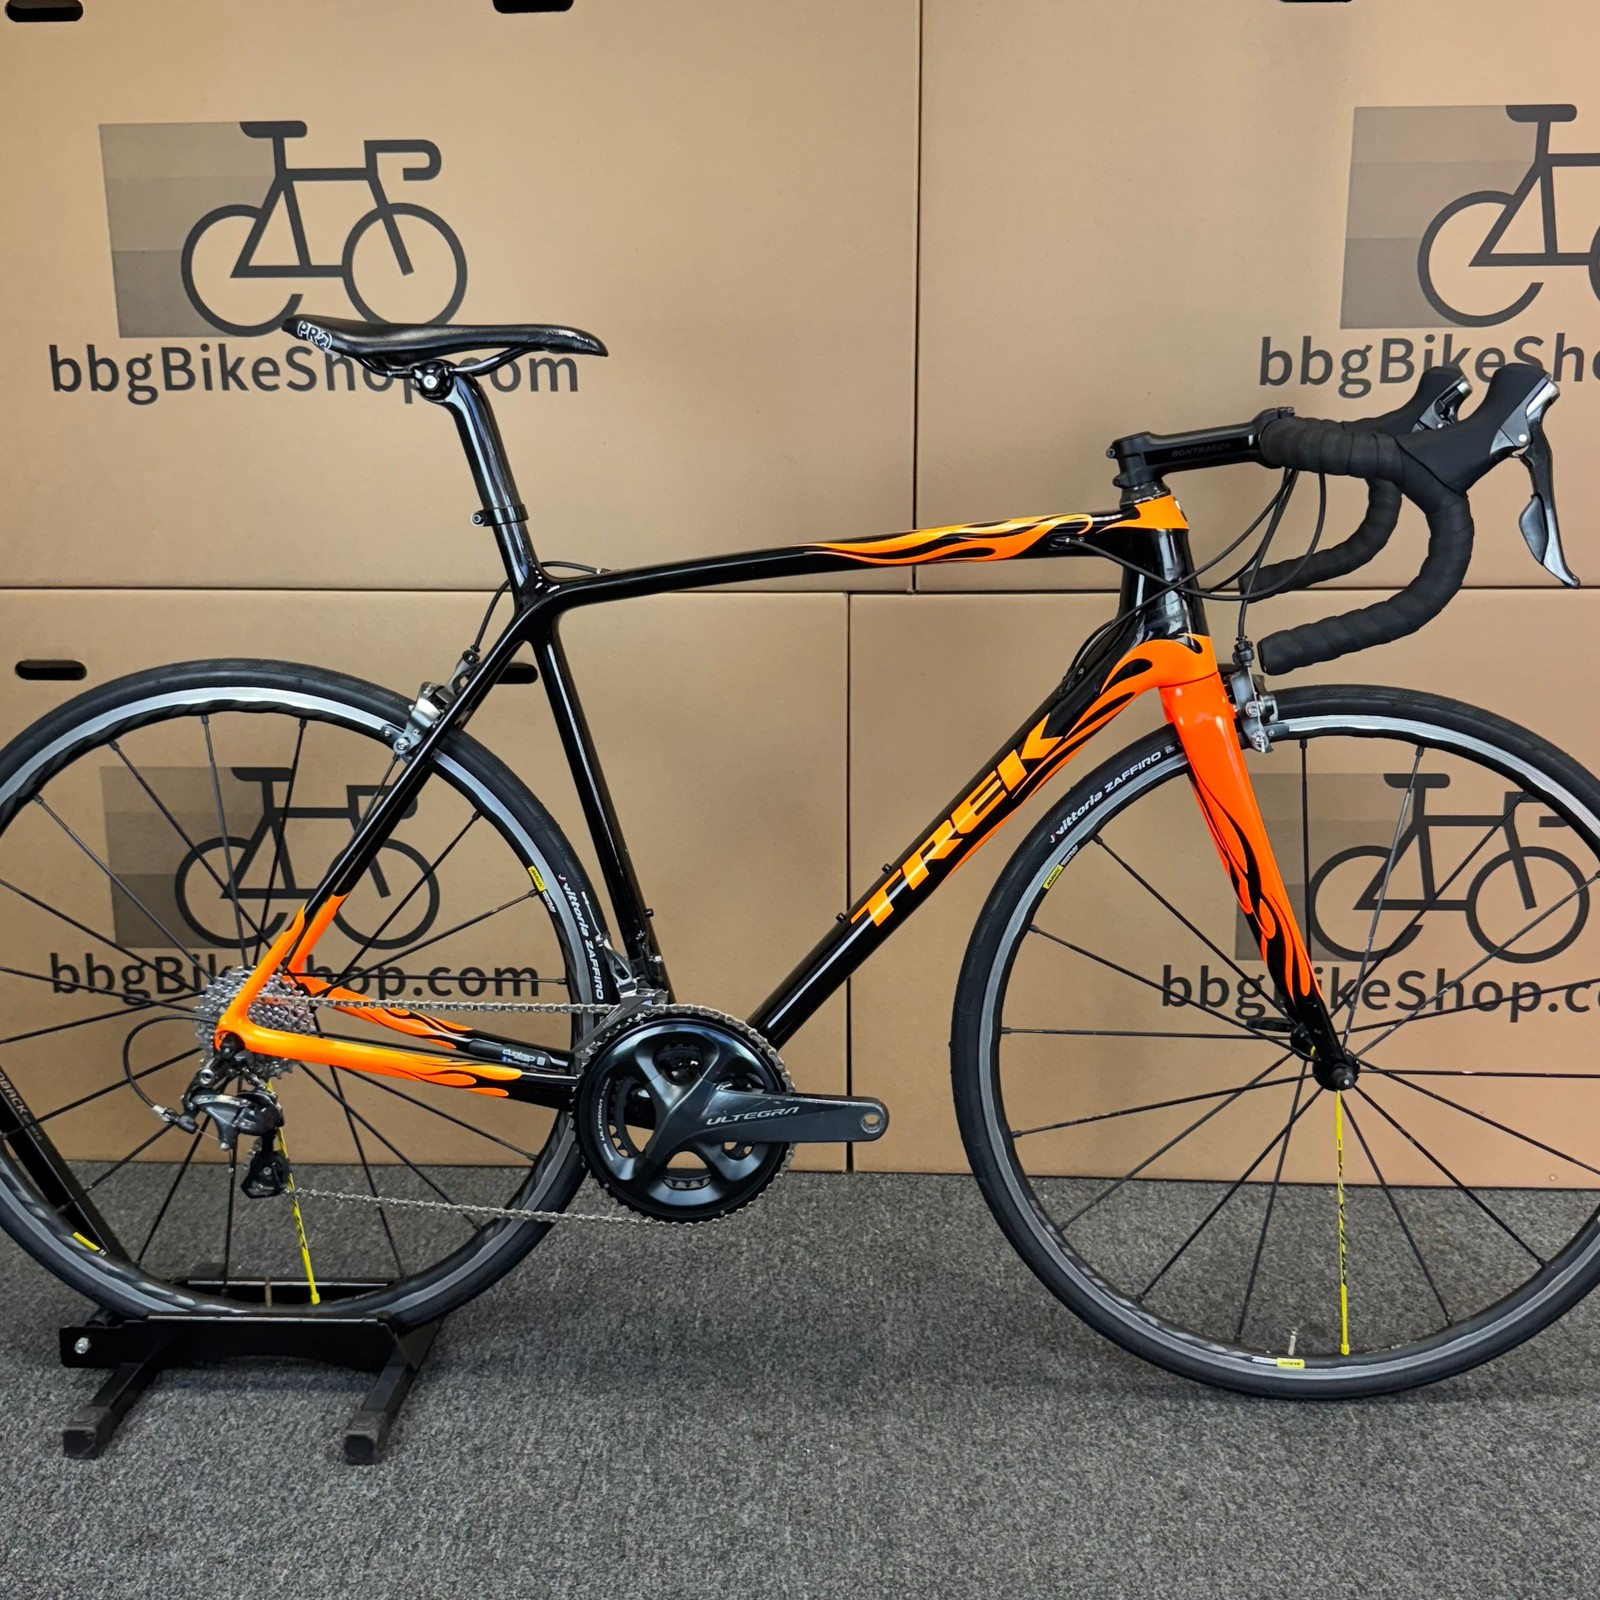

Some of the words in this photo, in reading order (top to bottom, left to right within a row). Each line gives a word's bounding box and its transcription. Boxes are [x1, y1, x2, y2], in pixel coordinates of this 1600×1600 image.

[49, 343, 578, 405] bbgBikeShoom
[1259, 333, 1600, 398] bbgBikeSh
[1171, 443, 1231, 457] BONTRAGER
[1105, 751, 1162, 793] ZAFFIRO
[851, 712, 1063, 927] TREK
[50, 952, 539, 1006] bbgBikhop.com
[585, 940, 604, 1000] ZAFFIRO
[1162, 964, 1600, 1023] bbgikeShop.c
[706, 1106, 800, 1126] ULTEGRA
